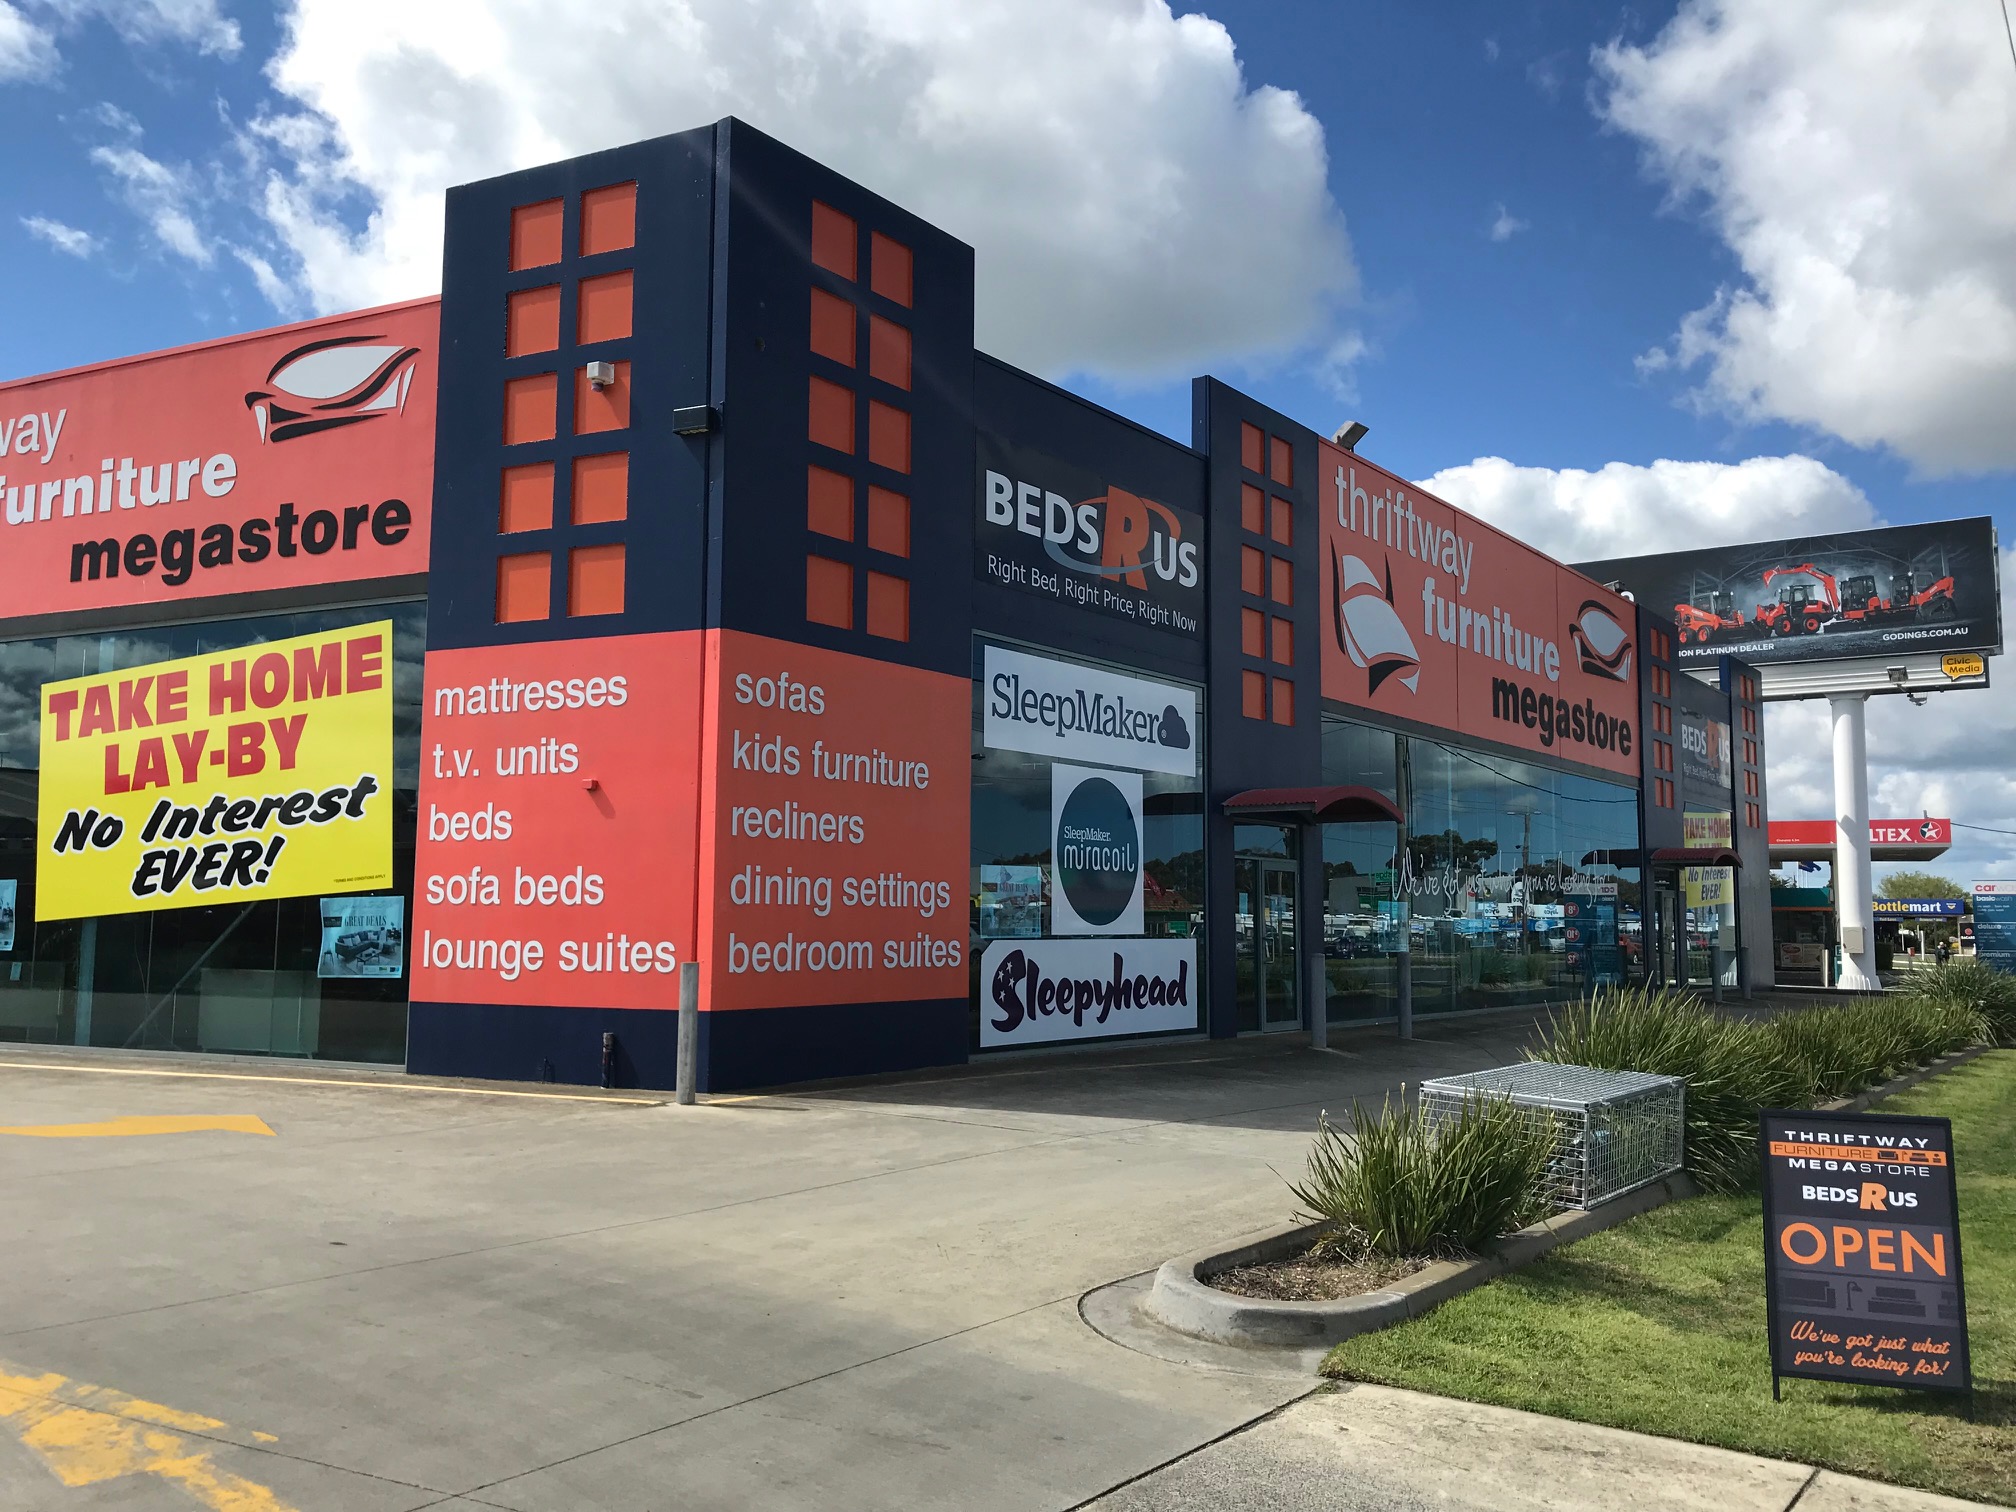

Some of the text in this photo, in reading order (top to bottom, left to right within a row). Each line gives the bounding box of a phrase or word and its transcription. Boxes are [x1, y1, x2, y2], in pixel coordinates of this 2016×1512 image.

[70, 499, 411, 586] megastore
[986, 469, 1099, 555] BEDS
[1154, 531, 1198, 588] US
[1334, 465, 1473, 595] thriftway
[988, 554, 1196, 632] Right Bed, Right Price, Right Now
[1422, 576, 1560, 682] furniture
[1882, 627, 1969, 641] GODINGS.COM.AU
[1695, 646, 1738, 656] PLATINUM
[1740, 643, 1775, 652] DEALER
[1946, 656, 1971, 665] Civic
[1949, 664, 1980, 673] Media
[49, 634, 382, 742] TAKE HOME
[434, 676, 628, 716] mattresses
[735, 671, 825, 715] sofas
[991, 673, 1159, 743] SleepMaker
[1492, 676, 1632, 756] megastore
[104, 713, 308, 795] LAY-BY
[433, 738, 579, 779] t.v. units
[1682, 723, 1706, 755] BEDS
[733, 730, 930, 790] kids furniture
[53, 775, 378, 853] No Interest
[429, 803, 513, 841] beds
[731, 802, 864, 845] recliners
[1684, 818, 1730, 839] TAKE HOME
[1869, 827, 1911, 842] LTEX
[131, 835, 286, 896] EVER!
[1064, 843, 1134, 872] miracoil
[1688, 866, 1731, 882] No Interest
[426, 866, 604, 906] sofa beds
[730, 865, 950, 918] dining settings
[1392, 846, 1440, 900] We've
[1443, 857, 1463, 915] got
[1701, 883, 1721, 901] EVER!
[345, 915, 365, 927] GREAT
[366, 915, 387, 927] DEALS
[1872, 901, 1941, 912] Bottlemart
[423, 930, 676, 981] lounge suites
[728, 933, 962, 974] bedroom suites
[991, 949, 1187, 1032] Sleepyhead
[1774, 1144, 1872, 1159] FURNITURE
[1785, 1130, 1929, 1148] THRIFTWAY
[1788, 1158, 1930, 1177] MEGASTORE
[1802, 1185, 1858, 1203] BEDS
[1889, 1191, 1918, 1207] US
[1781, 1222, 1947, 1277] OPEN
[1790, 1321, 1950, 1355] We've got just what
[1794, 1351, 1949, 1376] you're looking for!
